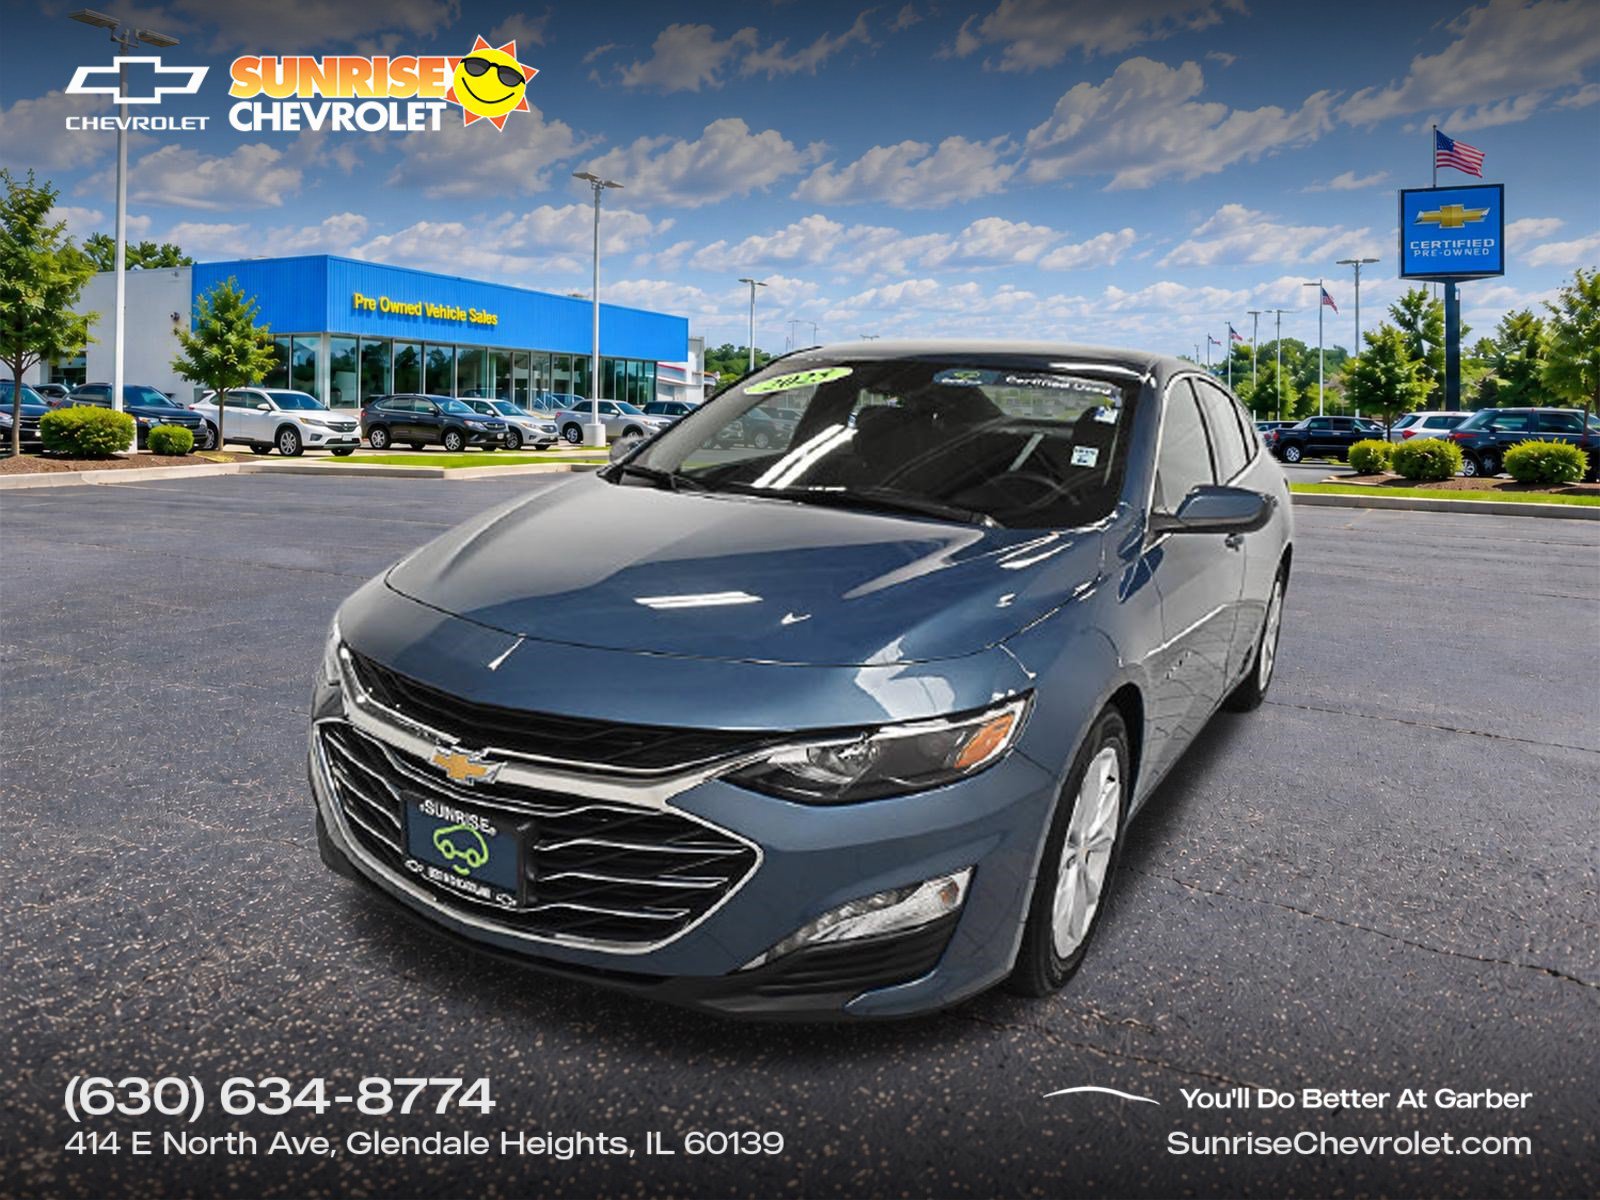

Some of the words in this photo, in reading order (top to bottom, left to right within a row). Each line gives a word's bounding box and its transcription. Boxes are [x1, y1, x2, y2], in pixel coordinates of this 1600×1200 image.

[1410, 238, 1495, 250] CERTIFIED
[1414, 247, 1490, 257] PRE-OWNED
[353, 293, 377, 311] Pre
[379, 296, 422, 316] Owned
[425, 302, 467, 321] Vehicle
[469, 308, 498, 325] Sales
[424, 799, 491, 833] SUNRISE
